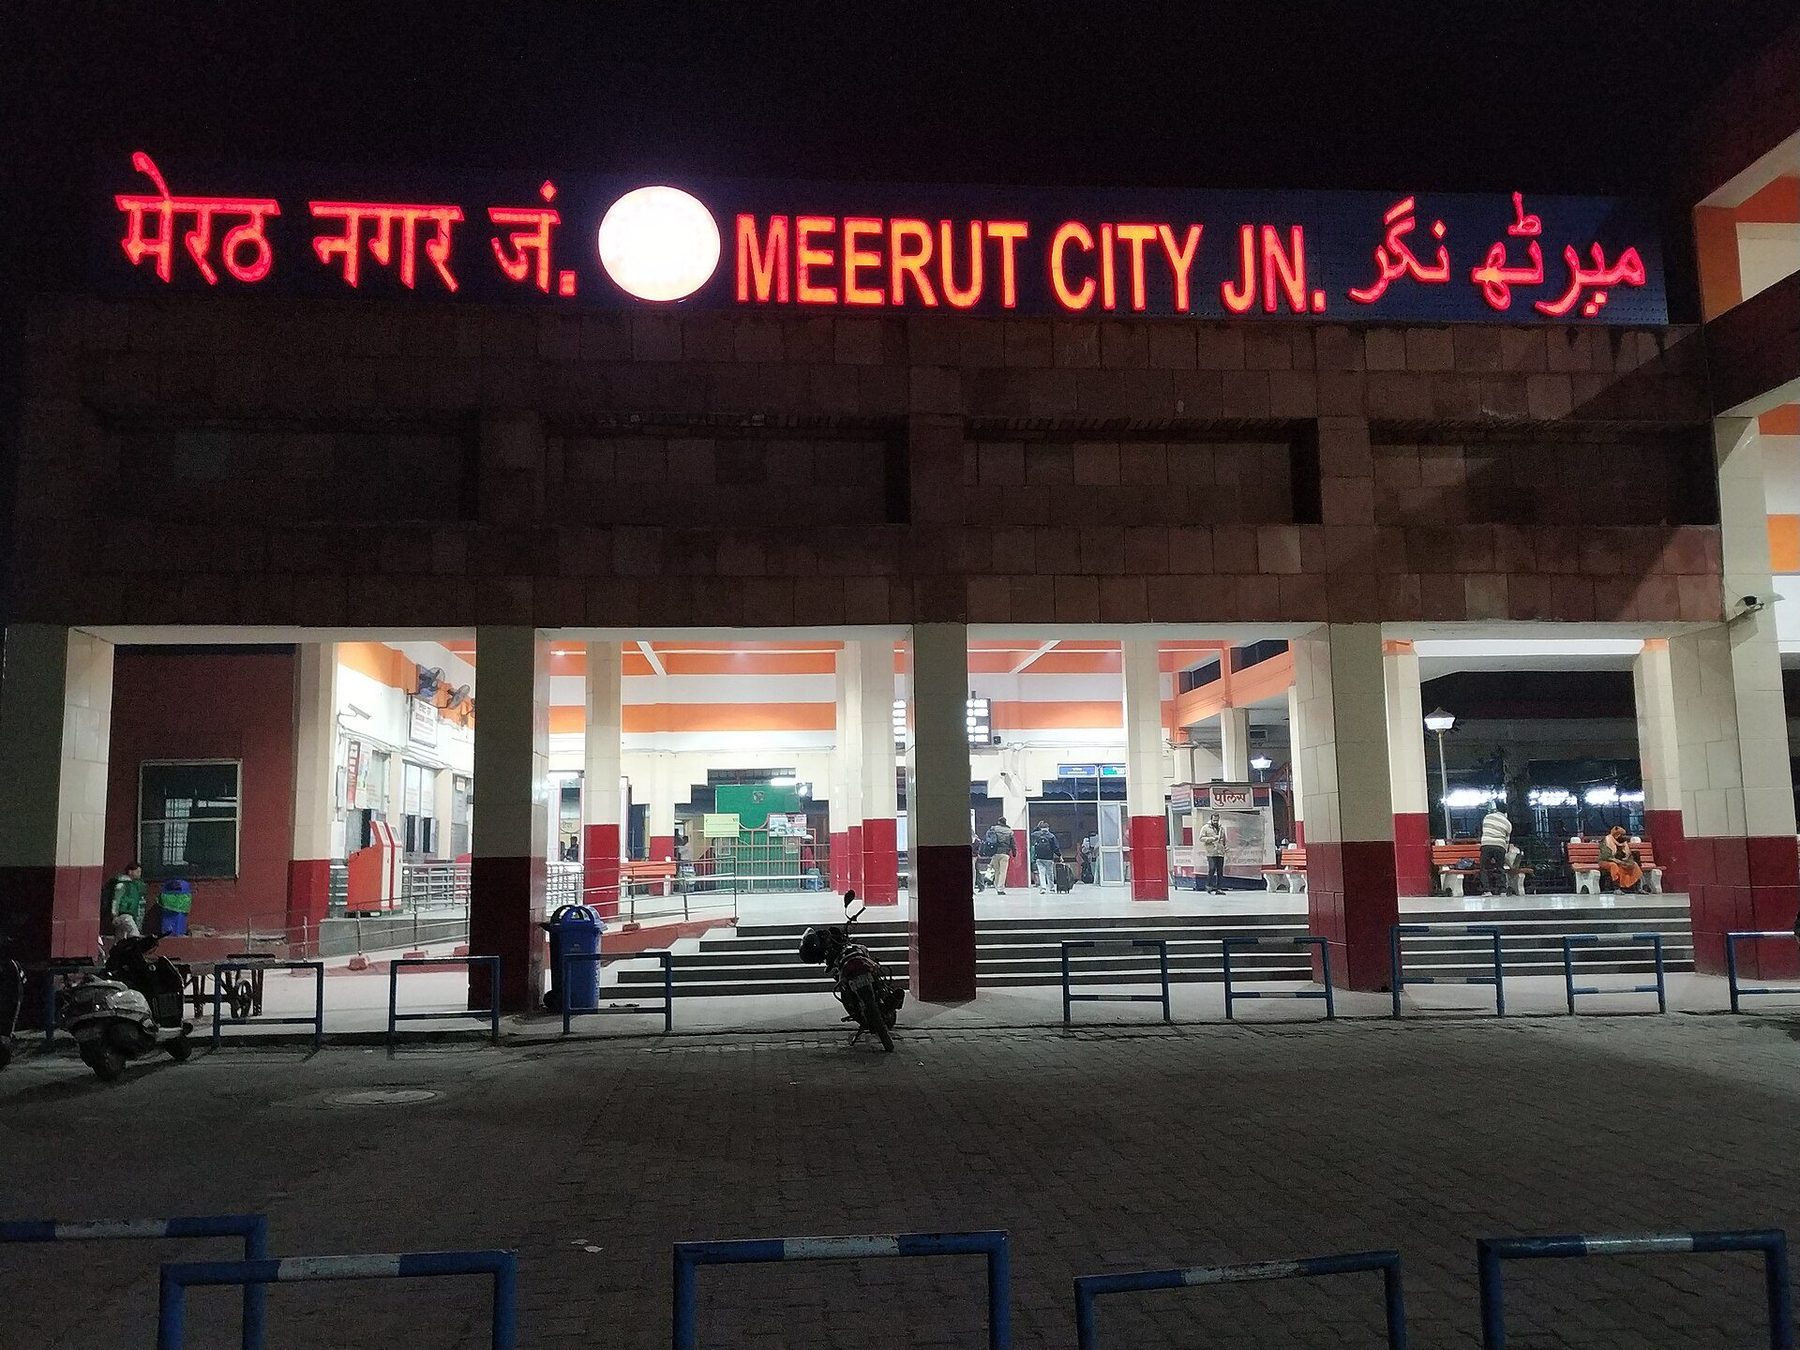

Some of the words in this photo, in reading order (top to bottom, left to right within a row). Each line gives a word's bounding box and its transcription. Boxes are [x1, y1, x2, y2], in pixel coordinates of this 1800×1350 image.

[114, 151, 281, 285] मेरठ
[308, 200, 465, 293] नगर
[487, 179, 577, 297] जं.
[734, 212, 1030, 310] MEERUT
[1048, 220, 1204, 315] CITY
[1221, 224, 1327, 314] JN.
[1348, 195, 1451, 304] نگر
[1471, 191, 1647, 317] میرٹھ
[1212, 789, 1247, 807] पुलिस
